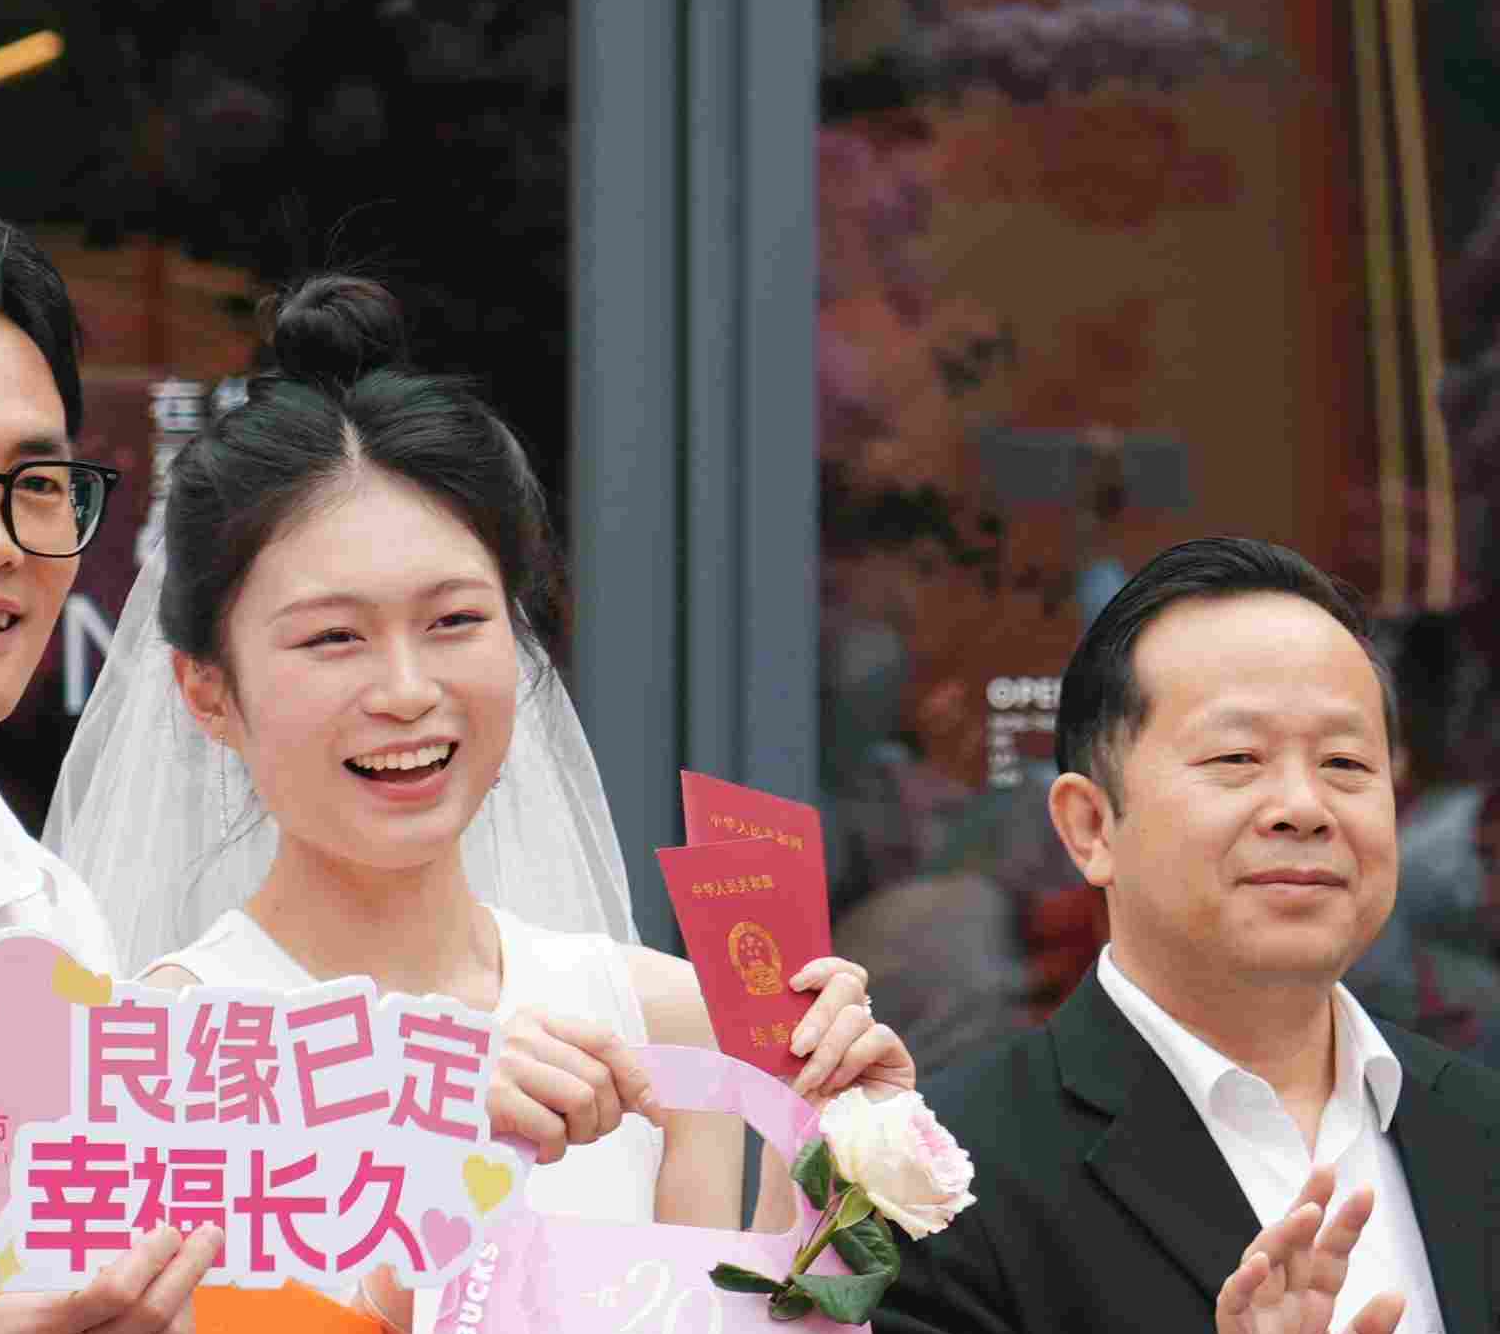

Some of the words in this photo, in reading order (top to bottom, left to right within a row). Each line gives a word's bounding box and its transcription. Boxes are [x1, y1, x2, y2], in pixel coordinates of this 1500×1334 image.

[88, 994, 490, 1141] 良缘已定
[25, 1135, 425, 1272] 幸福长久
